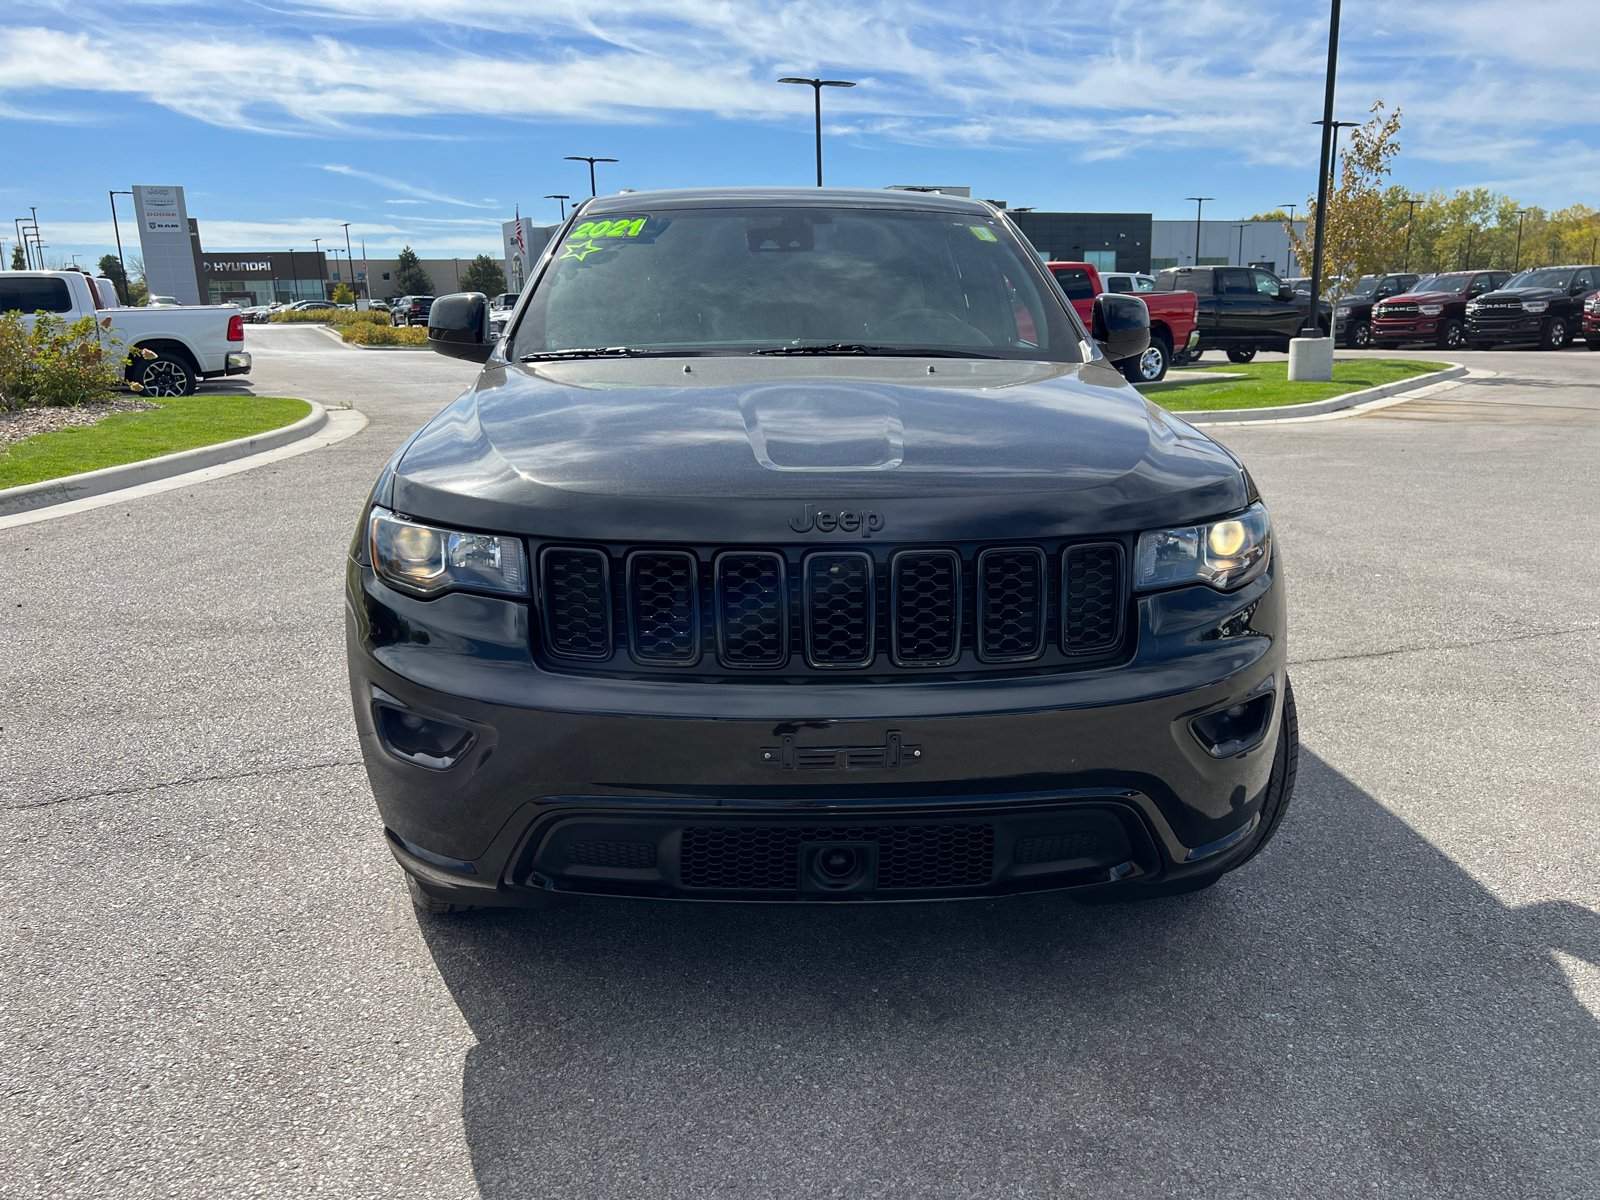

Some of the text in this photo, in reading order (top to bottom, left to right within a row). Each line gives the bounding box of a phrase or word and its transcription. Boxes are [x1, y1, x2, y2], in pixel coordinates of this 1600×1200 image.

[147, 187, 169, 196] Jeep
[570, 218, 646, 239] 2021
[213, 261, 272, 272] HYUNDAI
[789, 503, 885, 538] Jeep
